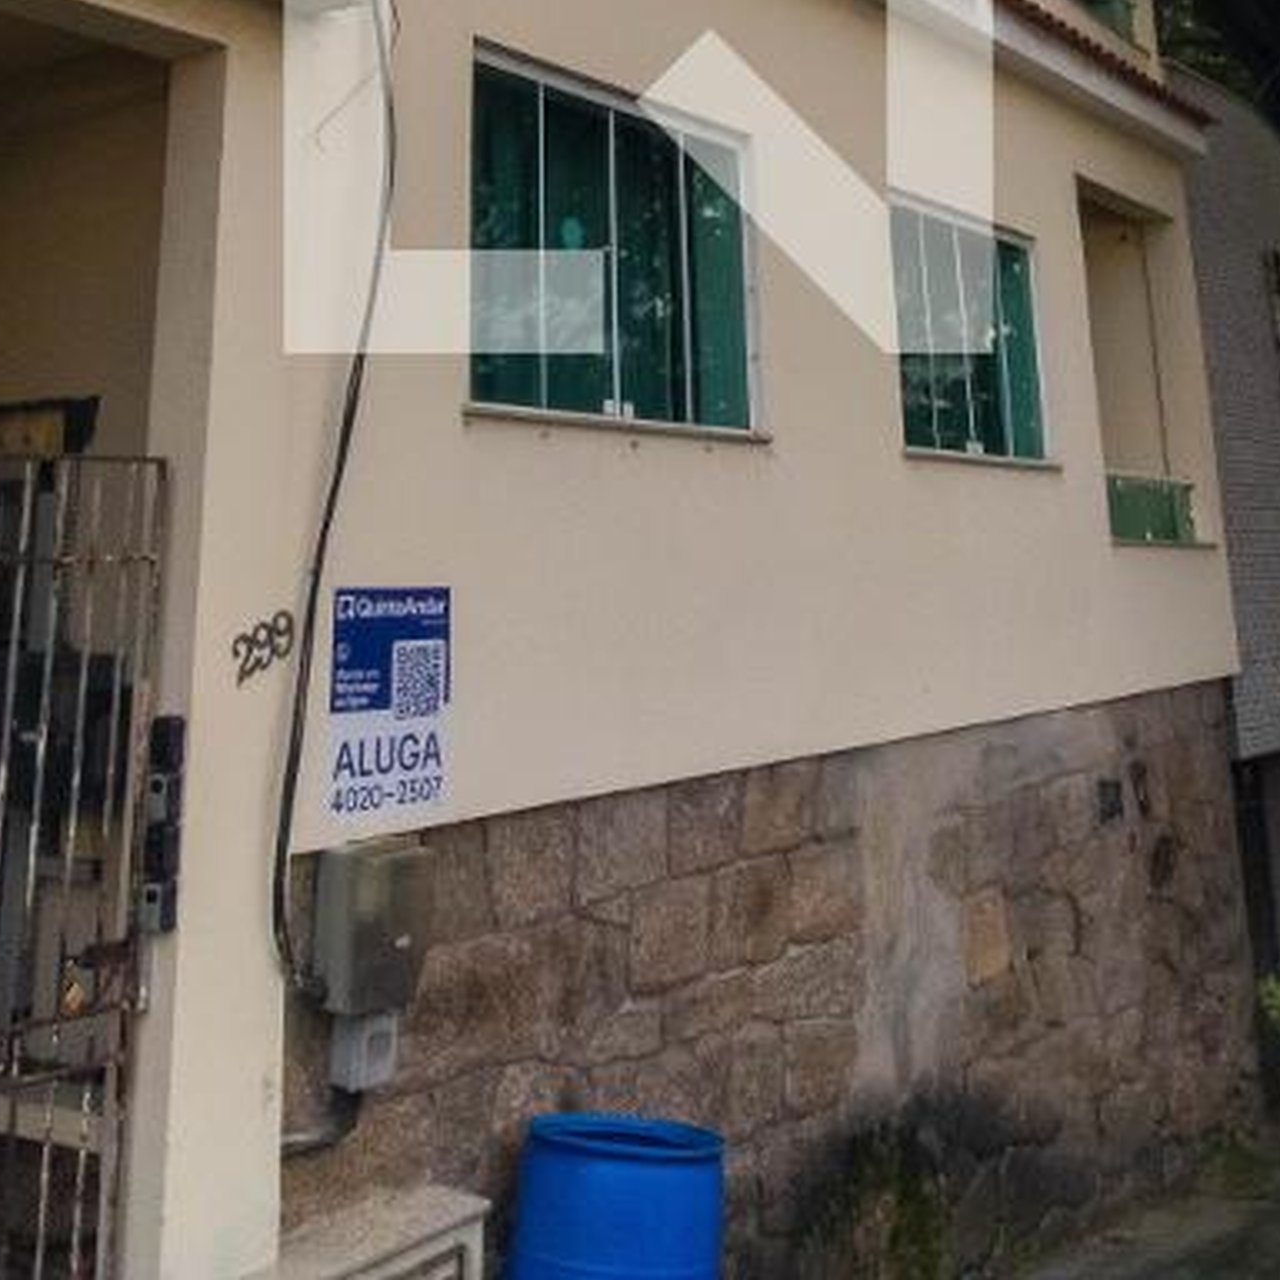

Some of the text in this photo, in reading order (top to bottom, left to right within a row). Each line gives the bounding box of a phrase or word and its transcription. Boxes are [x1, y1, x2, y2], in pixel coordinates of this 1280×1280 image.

[356, 596, 445, 618] QuintoAndar
[232, 609, 295, 688] 299
[332, 732, 442, 780] ALUGA
[331, 776, 443, 814] 4020-2507
